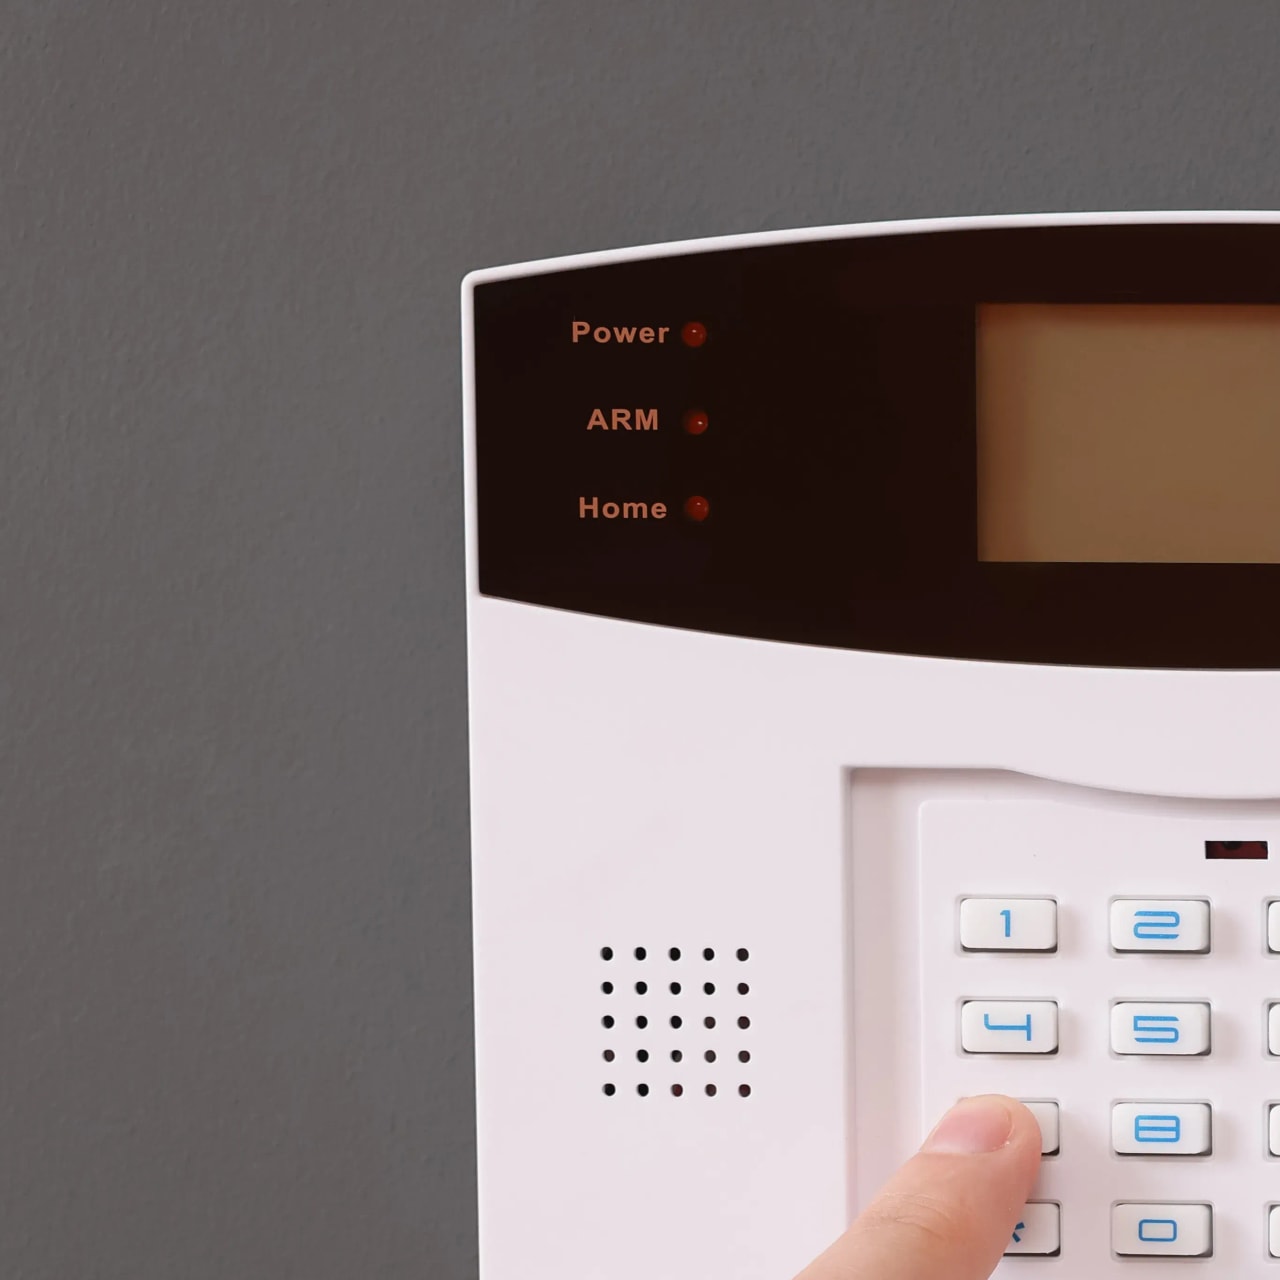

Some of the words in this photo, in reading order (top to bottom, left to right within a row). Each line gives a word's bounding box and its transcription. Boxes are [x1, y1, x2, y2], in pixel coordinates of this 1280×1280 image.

[572, 321, 670, 344] Power
[586, 408, 659, 431] ARM
[579, 496, 667, 519] Home
[1000, 909, 1012, 938] 1
[1133, 910, 1181, 940] 2
[983, 1013, 1032, 1042] 4
[1133, 1015, 1180, 1044] 5
[1134, 1114, 1181, 1144] 8
